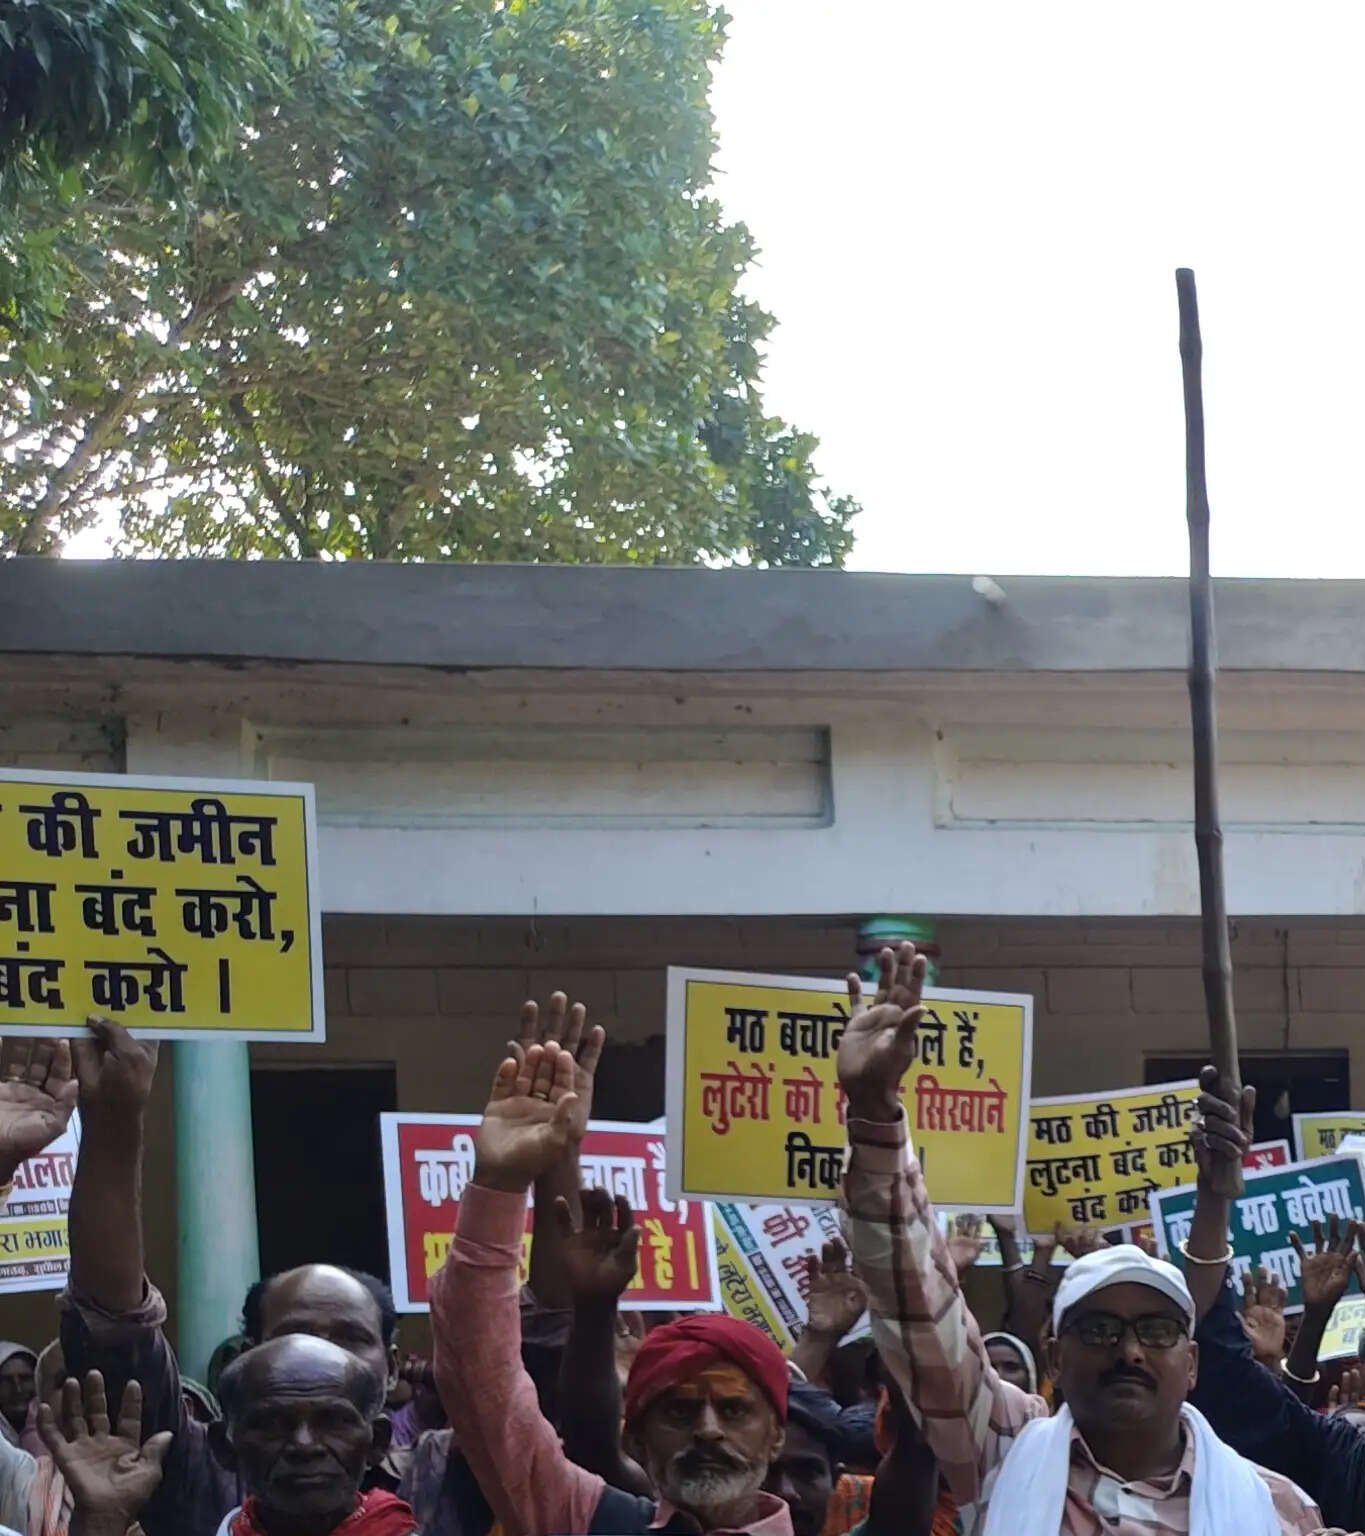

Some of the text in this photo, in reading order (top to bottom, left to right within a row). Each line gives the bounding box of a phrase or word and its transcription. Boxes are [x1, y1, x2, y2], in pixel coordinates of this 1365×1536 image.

[19, 792, 278, 866] की जमीन
[75, 869, 294, 953] बंद करो,
[84, 947, 188, 1013] करो
[725, 1007, 768, 1054] मठ
[700, 1061, 775, 1135] लुटेरों
[783, 1066, 823, 1124] को
[1030, 1104, 1119, 1144] मठ की
[1026, 1141, 1146, 1196] लुटना बंद
[1067, 1188, 1107, 1222] बंद
[1236, 1193, 1279, 1236] मठ
